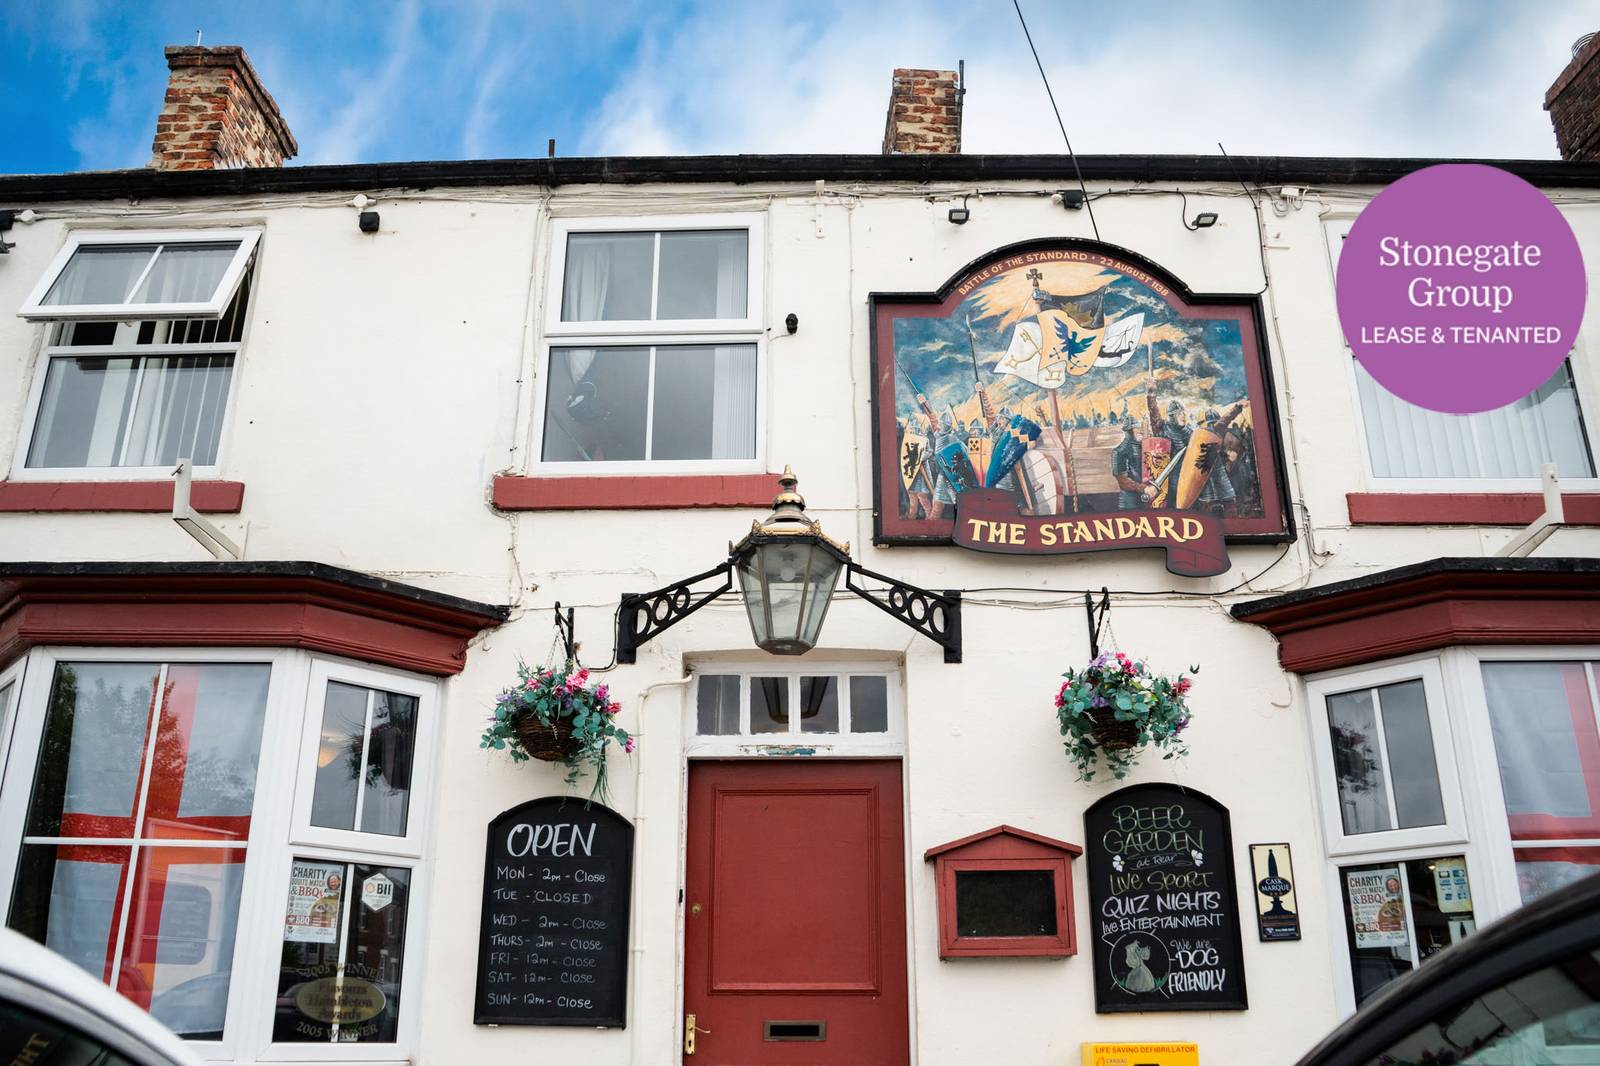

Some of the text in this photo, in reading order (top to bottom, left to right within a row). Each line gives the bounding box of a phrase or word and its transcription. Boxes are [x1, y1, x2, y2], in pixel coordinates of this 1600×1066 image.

[959, 251, 1170, 296] BATTLE OF THE STANDARD 22 AUGUST 1138
[968, 516, 1204, 545] THE STANDARD
[1112, 804, 1191, 832] BEER
[507, 822, 597, 857] OPEN
[1103, 829, 1204, 854] GARDEN
[1136, 858, 1150, 868] at
[292, 867, 327, 880] CHARITY
[497, 866, 525, 880] MON
[574, 869, 606, 882] Close
[1147, 871, 1213, 891] SPORT
[1350, 875, 1383, 888] CHARITY
[493, 888, 518, 900] TUE
[535, 890, 592, 904] CLOSED
[1102, 891, 1221, 918] QUIZ NIGHTS
[493, 913, 518, 926] WED
[572, 917, 607, 930] Close
[1119, 913, 1224, 931] ENTERTAINMENT
[491, 934, 524, 946] THURS
[570, 938, 602, 950] Close
[1170, 938, 1191, 950] We
[490, 952, 510, 965] FRI
[562, 956, 597, 967] Close
[1175, 948, 1219, 968] DOG
[337, 963, 384, 981] WINNER
[560, 972, 596, 984] Close
[1168, 968, 1226, 994] FRIENDLY
[557, 996, 593, 1009] Close
[296, 1021, 378, 1039] 2005 WINNER
